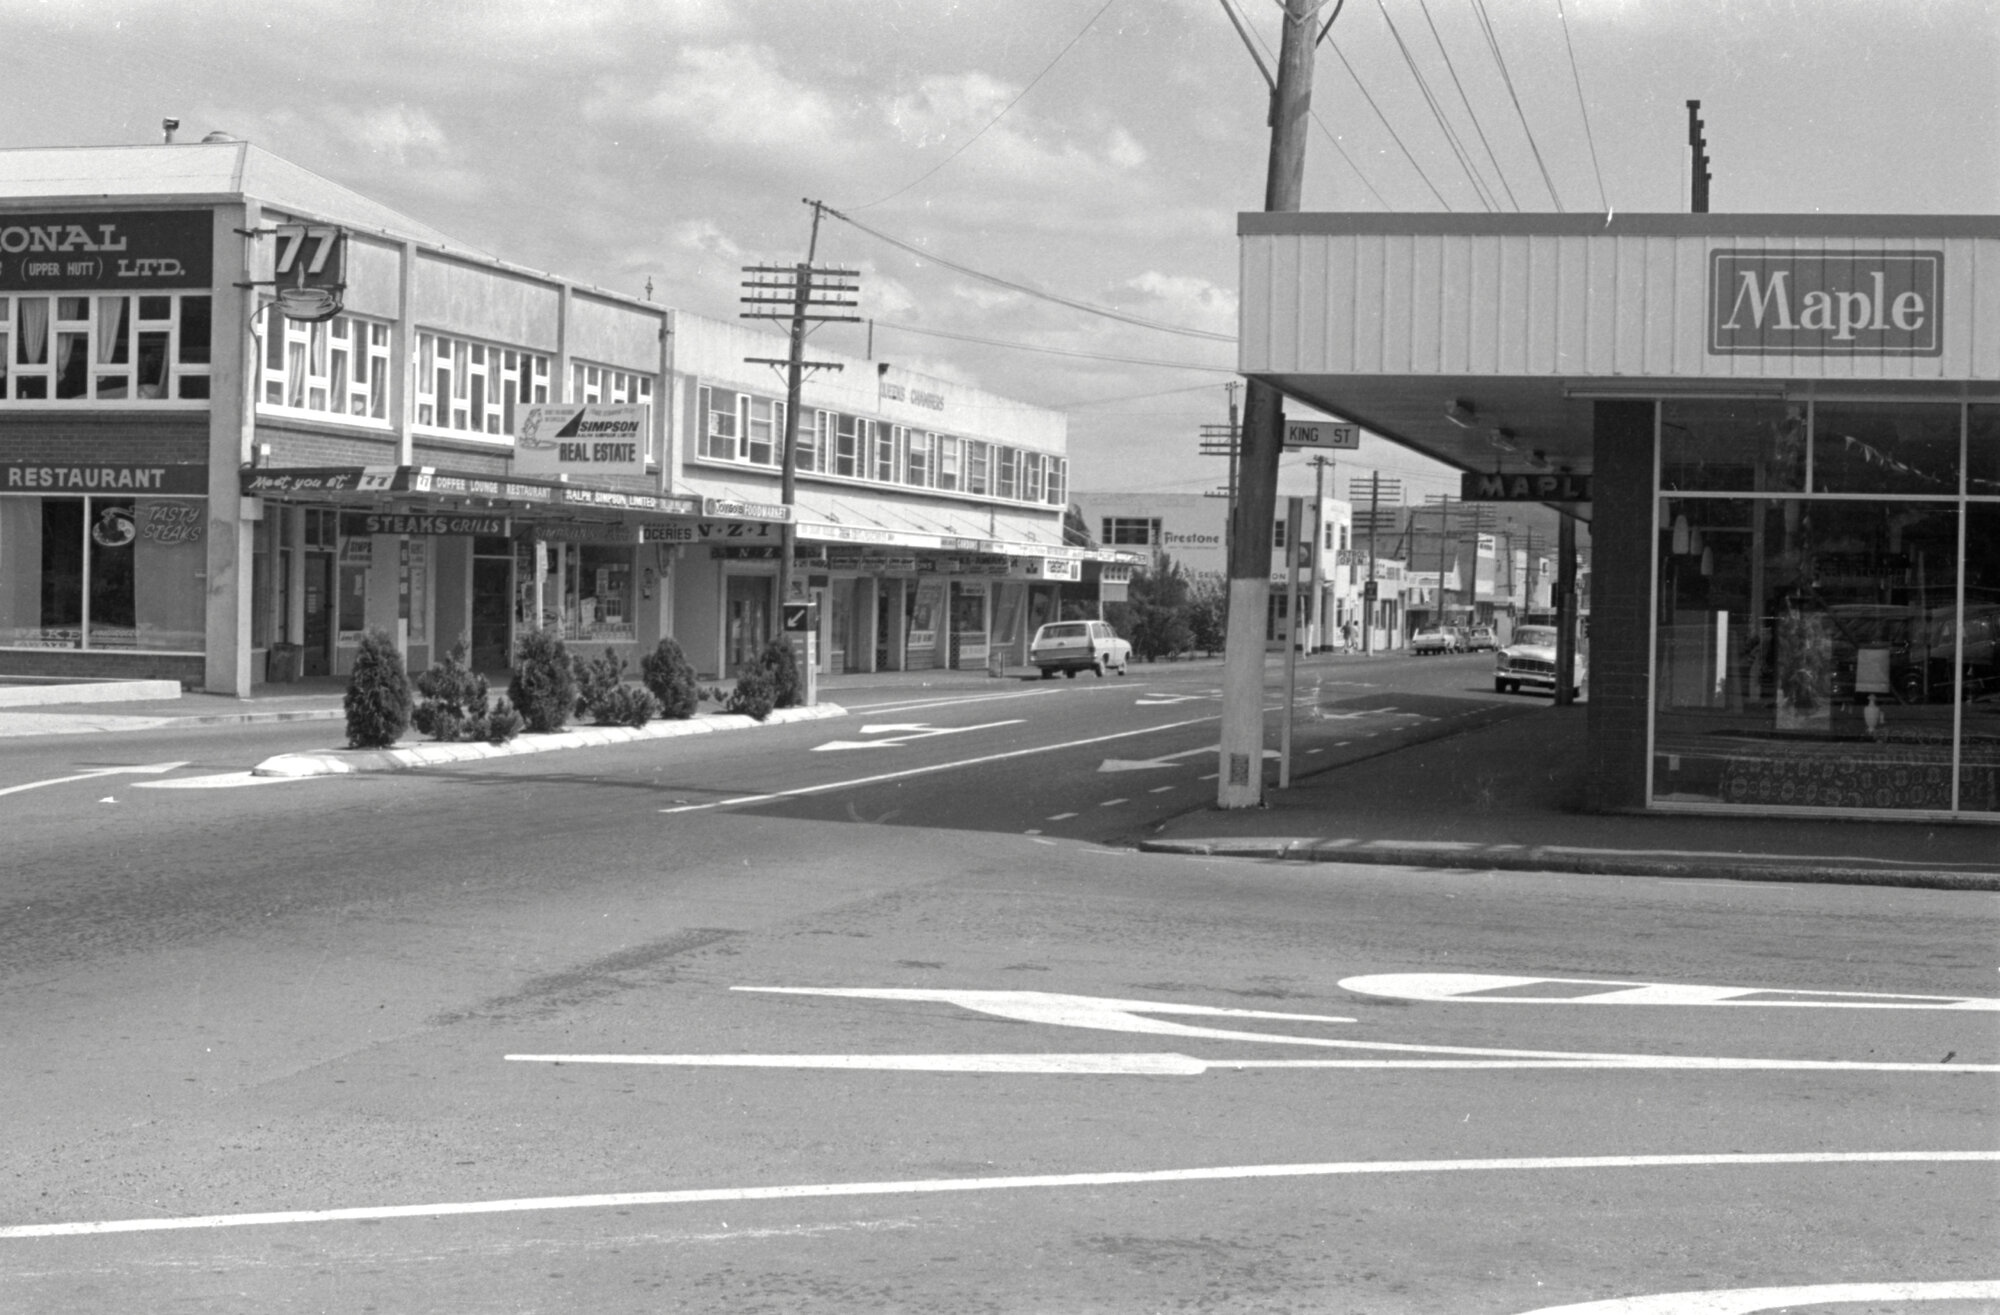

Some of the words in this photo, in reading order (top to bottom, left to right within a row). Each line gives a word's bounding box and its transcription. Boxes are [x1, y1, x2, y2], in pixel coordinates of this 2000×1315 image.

[0, 223, 127, 252] ONAL
[277, 226, 338, 273] 77
[117, 258, 187, 277] LTD.
[1721, 270, 1925, 340] Maple
[579, 420, 639, 432] SIMPSON
[1289, 426, 1319, 442] KING
[1333, 428, 1351, 443] ST
[559, 442, 590, 462] REAL
[593, 442, 636, 462] ESTATE
[9, 467, 165, 488] RESTAURANT
[249, 475, 291, 490] Meet
[294, 477, 323, 491] you
[366, 475, 392, 487] 77
[436, 476, 466, 491] COFFEE
[470, 479, 499, 494] LOUNGE
[506, 482, 551, 499] RESTAURANT
[565, 489, 592, 502] RALPH
[594, 491, 627, 506] SIMPSON
[628, 495, 656, 508] LIMITED
[148, 505, 201, 523] TASTY
[144, 522, 202, 541] STEAKS
[366, 515, 448, 533] STEAKS
[450, 517, 499, 533] GRILLS
[643, 528, 692, 540] OCERIES
[1163, 530, 1220, 545] Firestone
